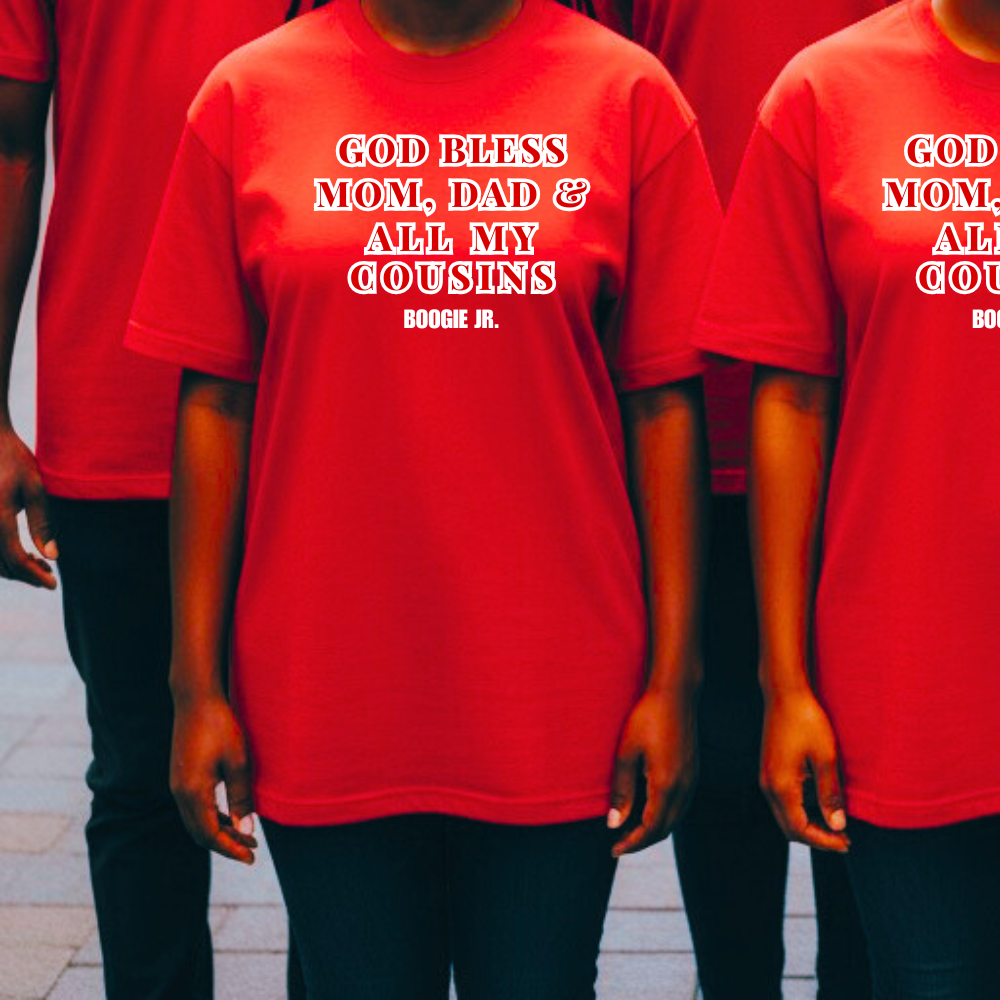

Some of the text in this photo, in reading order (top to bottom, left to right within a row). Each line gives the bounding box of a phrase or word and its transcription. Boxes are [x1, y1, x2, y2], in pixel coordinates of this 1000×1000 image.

[335, 133, 569, 168] GOD BLESS
[903, 133, 999, 168] GOD
[313, 177, 591, 218] MOM, DAD &
[363, 221, 540, 256] ALL MY
[347, 260, 557, 295] COUSINS
[403, 308, 499, 329] BOOGIE JR.
